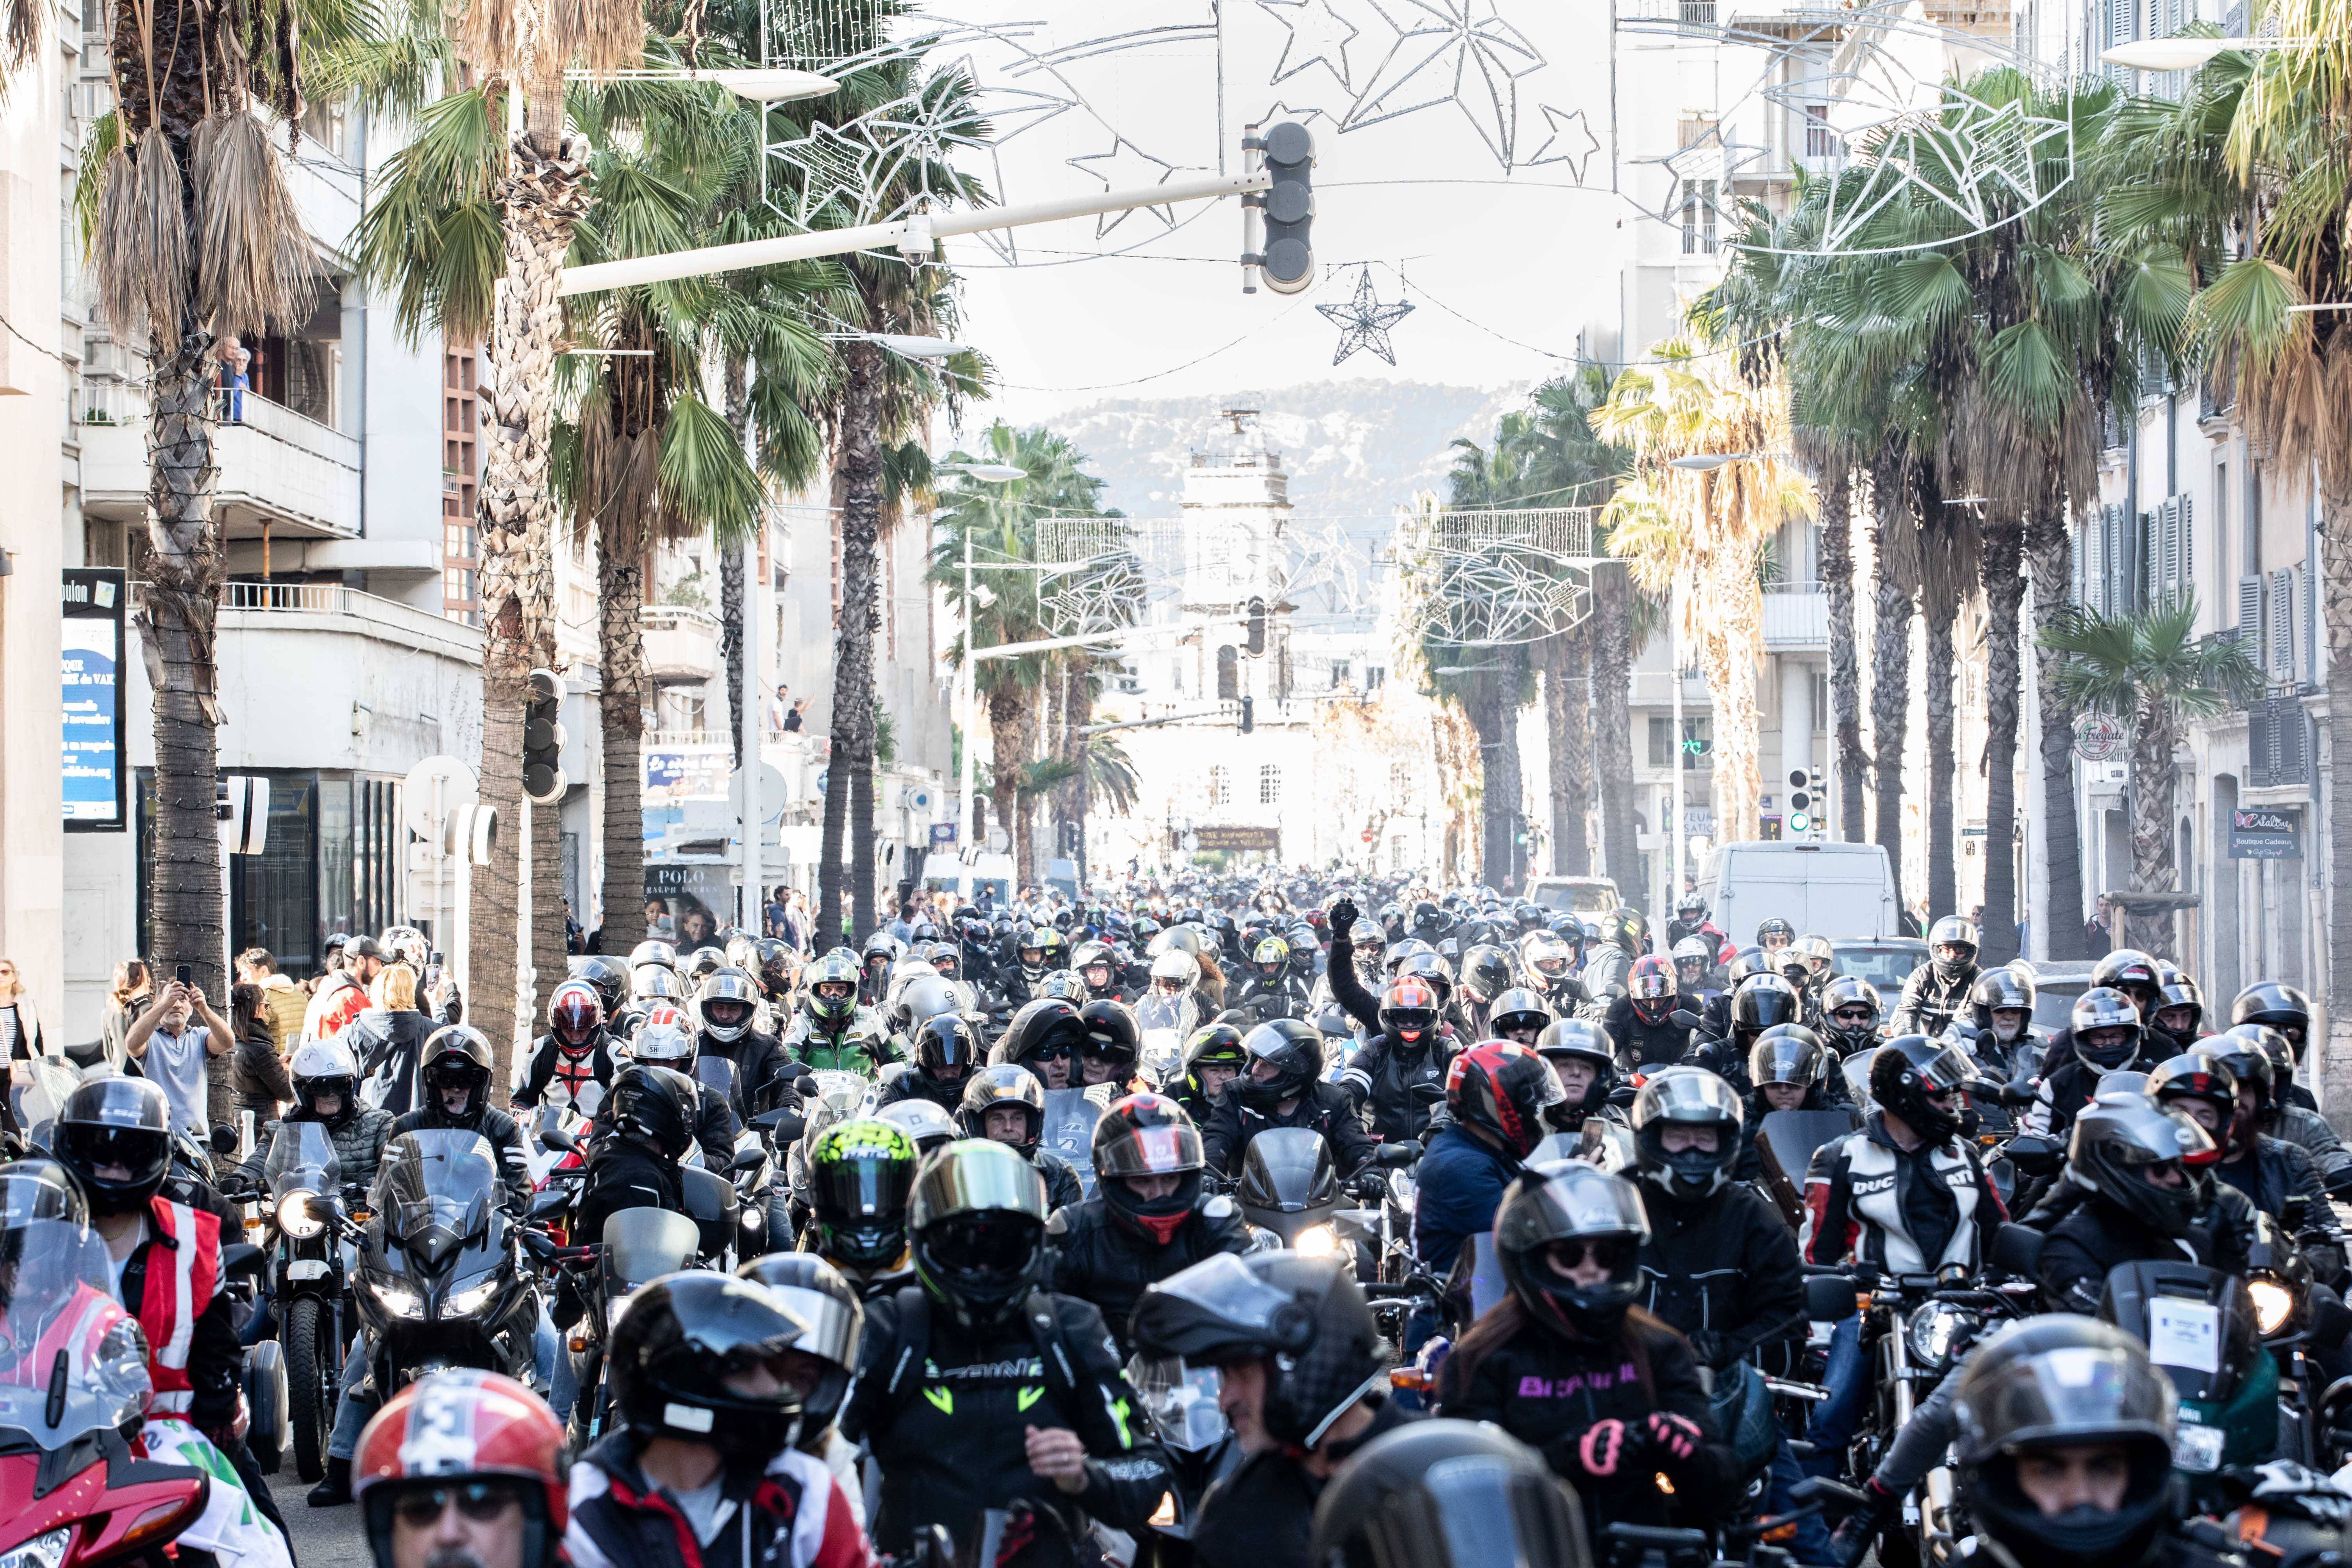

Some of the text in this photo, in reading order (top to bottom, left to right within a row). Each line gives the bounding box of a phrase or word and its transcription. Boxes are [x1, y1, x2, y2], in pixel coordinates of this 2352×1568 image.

[2083, 727, 2124, 744] Frégate
[659, 869, 704, 884] POLO
[646, 886, 676, 894] RALPH
[1852, 1175, 1895, 1195] DUC
